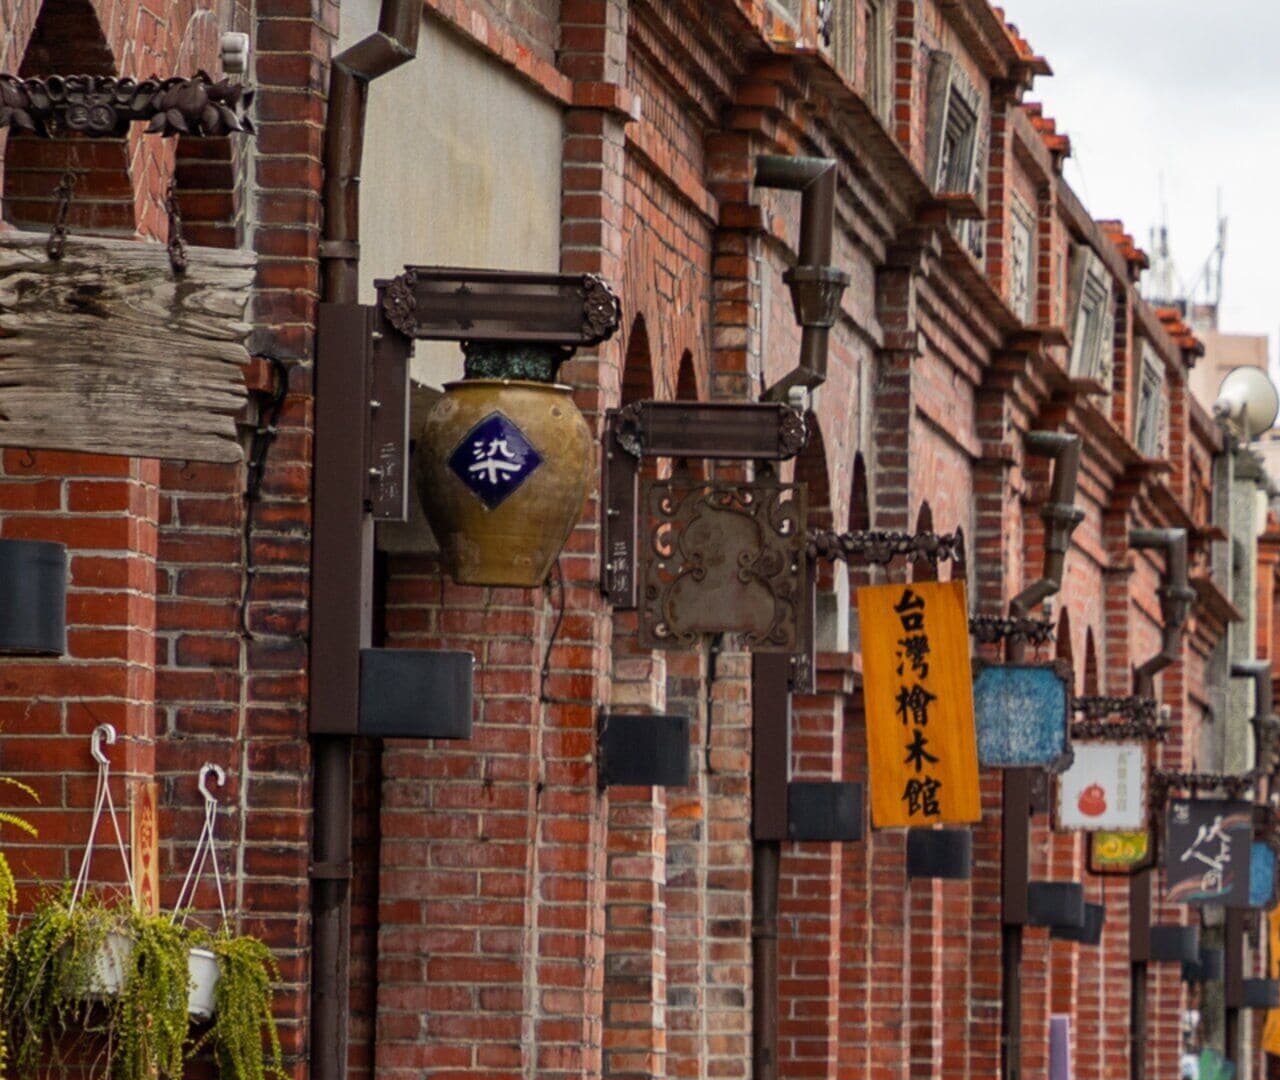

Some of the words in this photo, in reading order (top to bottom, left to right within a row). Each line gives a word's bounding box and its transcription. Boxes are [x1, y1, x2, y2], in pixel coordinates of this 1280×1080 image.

[467, 439, 522, 485] 染
[893, 588, 942, 818] 台灣檜木館
